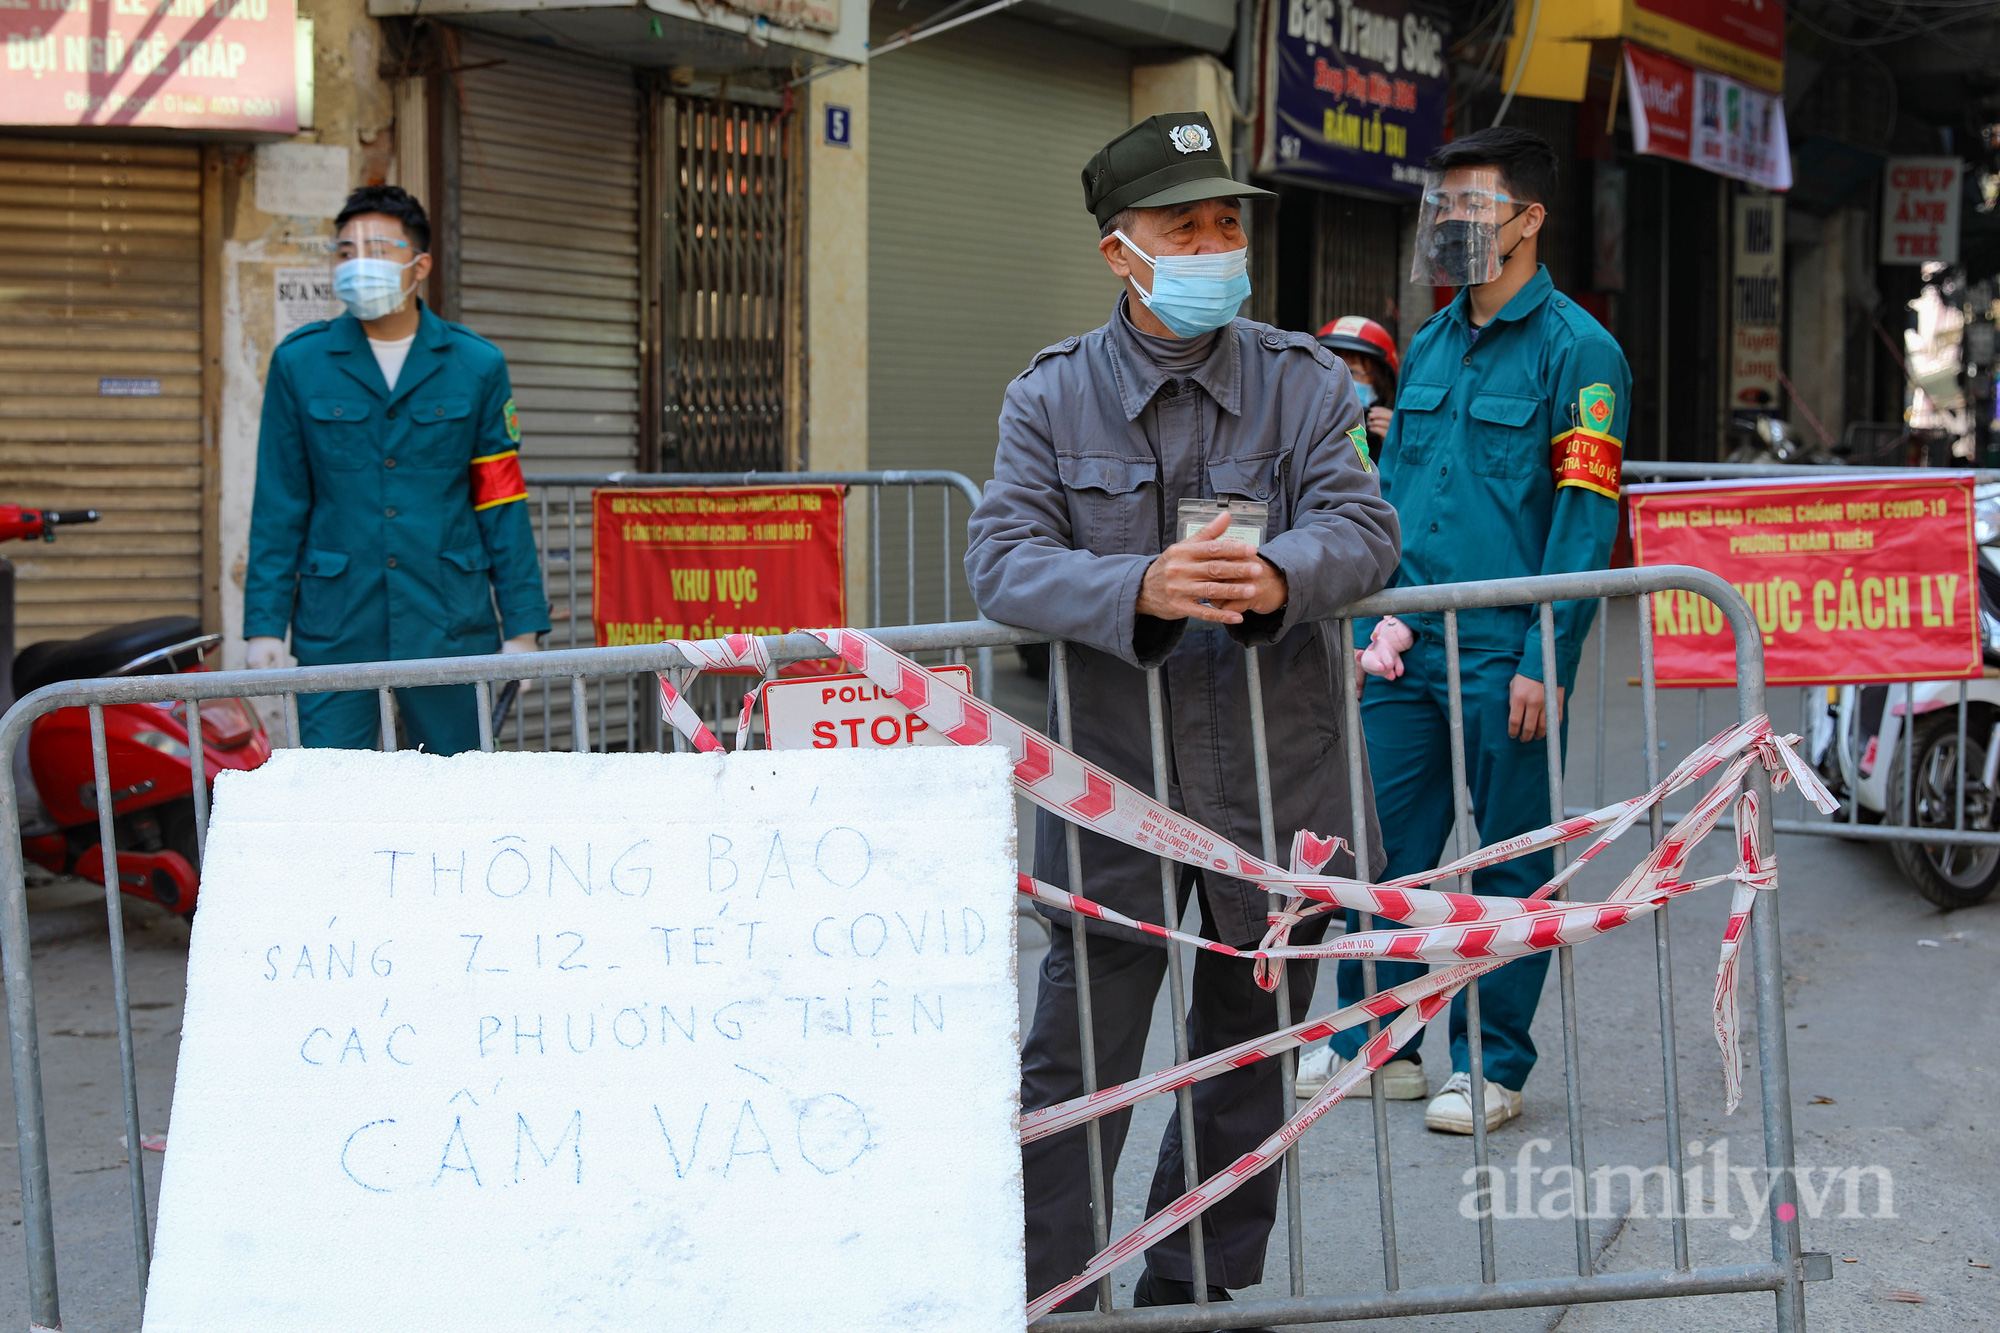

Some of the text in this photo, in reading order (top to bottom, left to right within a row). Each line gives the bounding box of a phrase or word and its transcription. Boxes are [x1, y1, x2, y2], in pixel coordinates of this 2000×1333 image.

[7, 27, 58, 80] ĐỘI
[64, 30, 125, 75] NGŨ
[178, 34, 248, 79] TRÁP
[833, 110, 844, 140] 5
[1891, 166, 1955, 195] CHỤP
[1589, 459, 1605, 478] BẢO
[1657, 511, 1687, 529] BAN
[1745, 504, 1793, 525] PHÒNG
[1796, 498, 1844, 523] CHỐNG
[1882, 498, 1948, 519] COVID-19
[1730, 527, 1875, 554] PHƯỜNG KHÂM THIÊN
[671, 565, 758, 610] KHU VỰC
[1654, 587, 1725, 636] KHU
[1813, 567, 1911, 632] CÁCH
[1920, 574, 1959, 627] LY
[812, 713, 930, 749] STOP
[1140, 820, 1209, 862] NOT ALLOWED AREA
[1146, 808, 1164, 824] KHU
[1164, 817, 1181, 833] VỰC
[373, 785, 873, 899] THÔNG BÁO
[263, 915, 393, 981] SÁNG
[813, 906, 987, 958] COVID
[300, 997, 417, 1066] CÁC
[340, 1062, 872, 1193] CẤM VÀO
